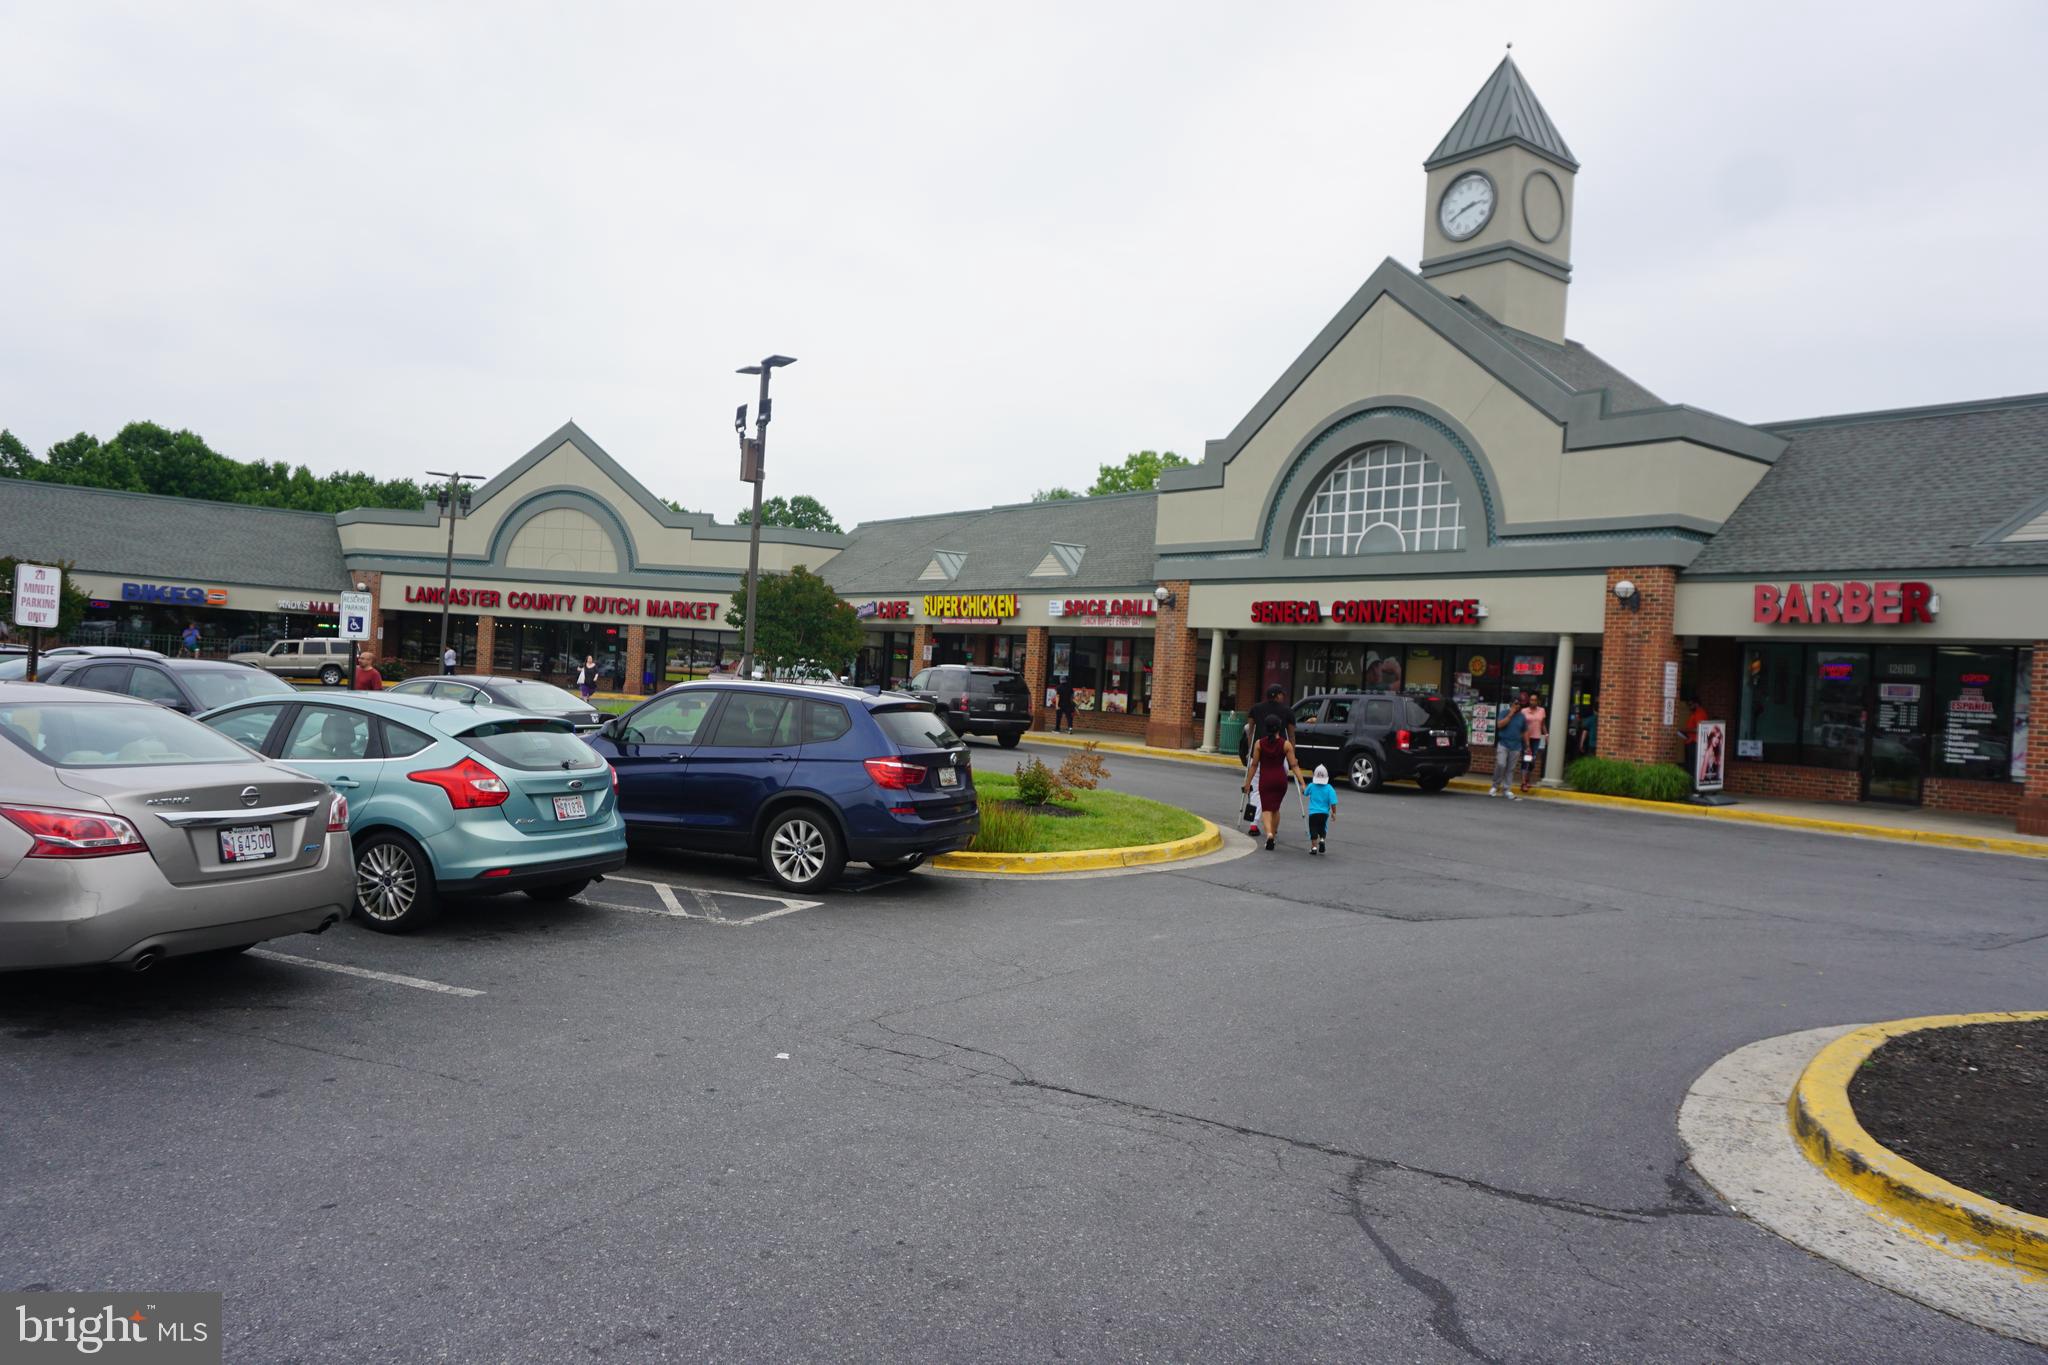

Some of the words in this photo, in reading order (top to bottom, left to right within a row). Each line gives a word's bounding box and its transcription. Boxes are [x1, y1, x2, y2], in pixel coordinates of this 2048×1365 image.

[35, 569, 46, 581] 20
[23, 583, 55, 595] MINUTE
[121, 582, 206, 606] BIKES
[20, 596, 56, 610] PARKING
[344, 603, 368, 612] PARKING
[405, 585, 501, 608] LANCASTER
[507, 591, 576, 612] COUNTY
[583, 595, 640, 616] DUTCH
[646, 600, 720, 620] MARKET
[877, 601, 909, 619] CAFE
[923, 595, 960, 617] SUPER
[960, 593, 1016, 617] CHICKEN
[1064, 599, 1108, 617] SPICE
[1110, 598, 1156, 617] GRILL
[1753, 581, 1934, 624] BARBER
[27, 611, 48, 623] ONLY
[1251, 600, 1321, 624] SENECA
[1331, 599, 1480, 625] CONVENIENCE
